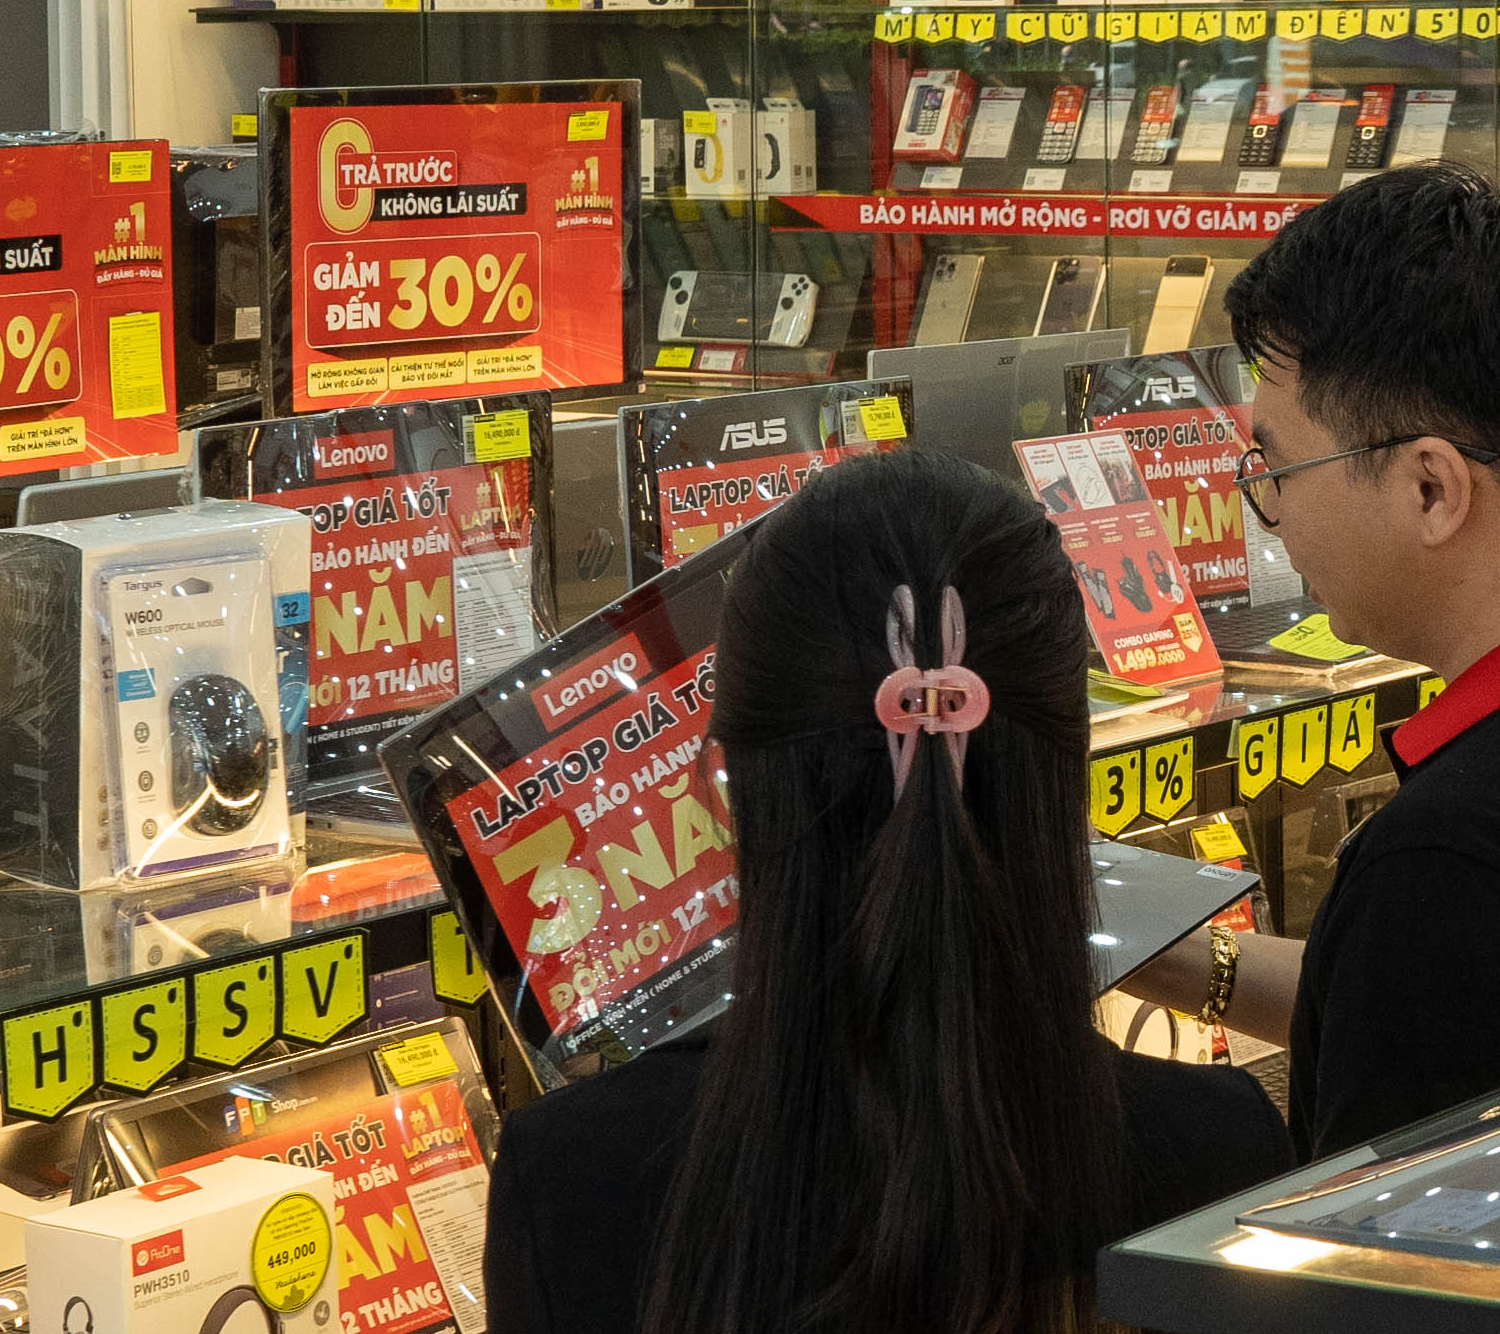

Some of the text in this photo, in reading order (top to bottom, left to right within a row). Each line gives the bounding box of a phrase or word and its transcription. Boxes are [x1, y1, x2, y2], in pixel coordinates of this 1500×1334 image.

[860, 199, 1257, 232] BẢO HÀNH MỞ RỘNG RƠI VỠ GIẢM
[4, 239, 54, 270] SUẤT
[721, 417, 787, 449] ASUS
[320, 440, 389, 469] Lenovo
[123, 578, 164, 594] Targus
[124, 608, 163, 625] W600
[1114, 629, 1174, 649] COMBO GAMING
[543, 650, 638, 717] Lenovo
[1107, 701, 1363, 816] 3% GIÁ
[33, 960, 338, 1089] HSSV
[266, 1240, 316, 1268] 449,000
[133, 1269, 190, 1299] PWH3510
